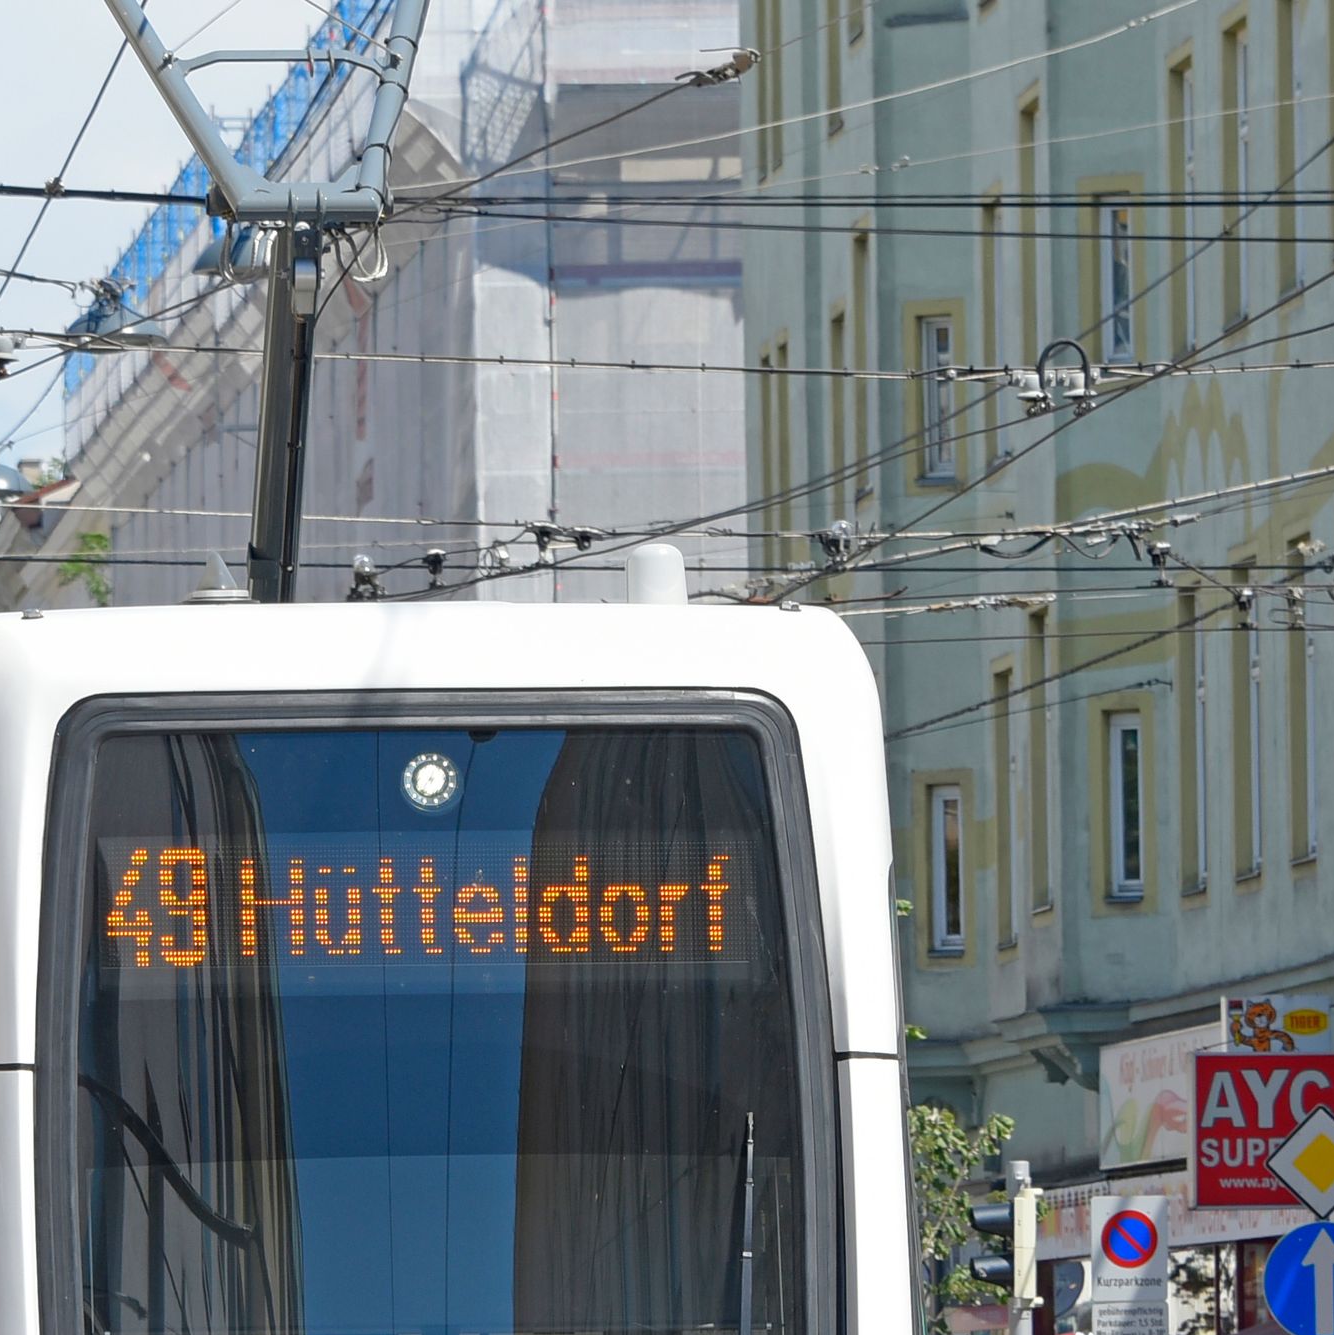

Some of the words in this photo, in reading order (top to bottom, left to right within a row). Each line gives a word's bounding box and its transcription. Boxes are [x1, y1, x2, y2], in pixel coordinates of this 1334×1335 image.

[107, 848, 204, 968] 49
[241, 855, 731, 955] Hütteldorf
[1290, 1015, 1320, 1029] TIGER
[1097, 1276, 1163, 1289] Kurzparkzone
